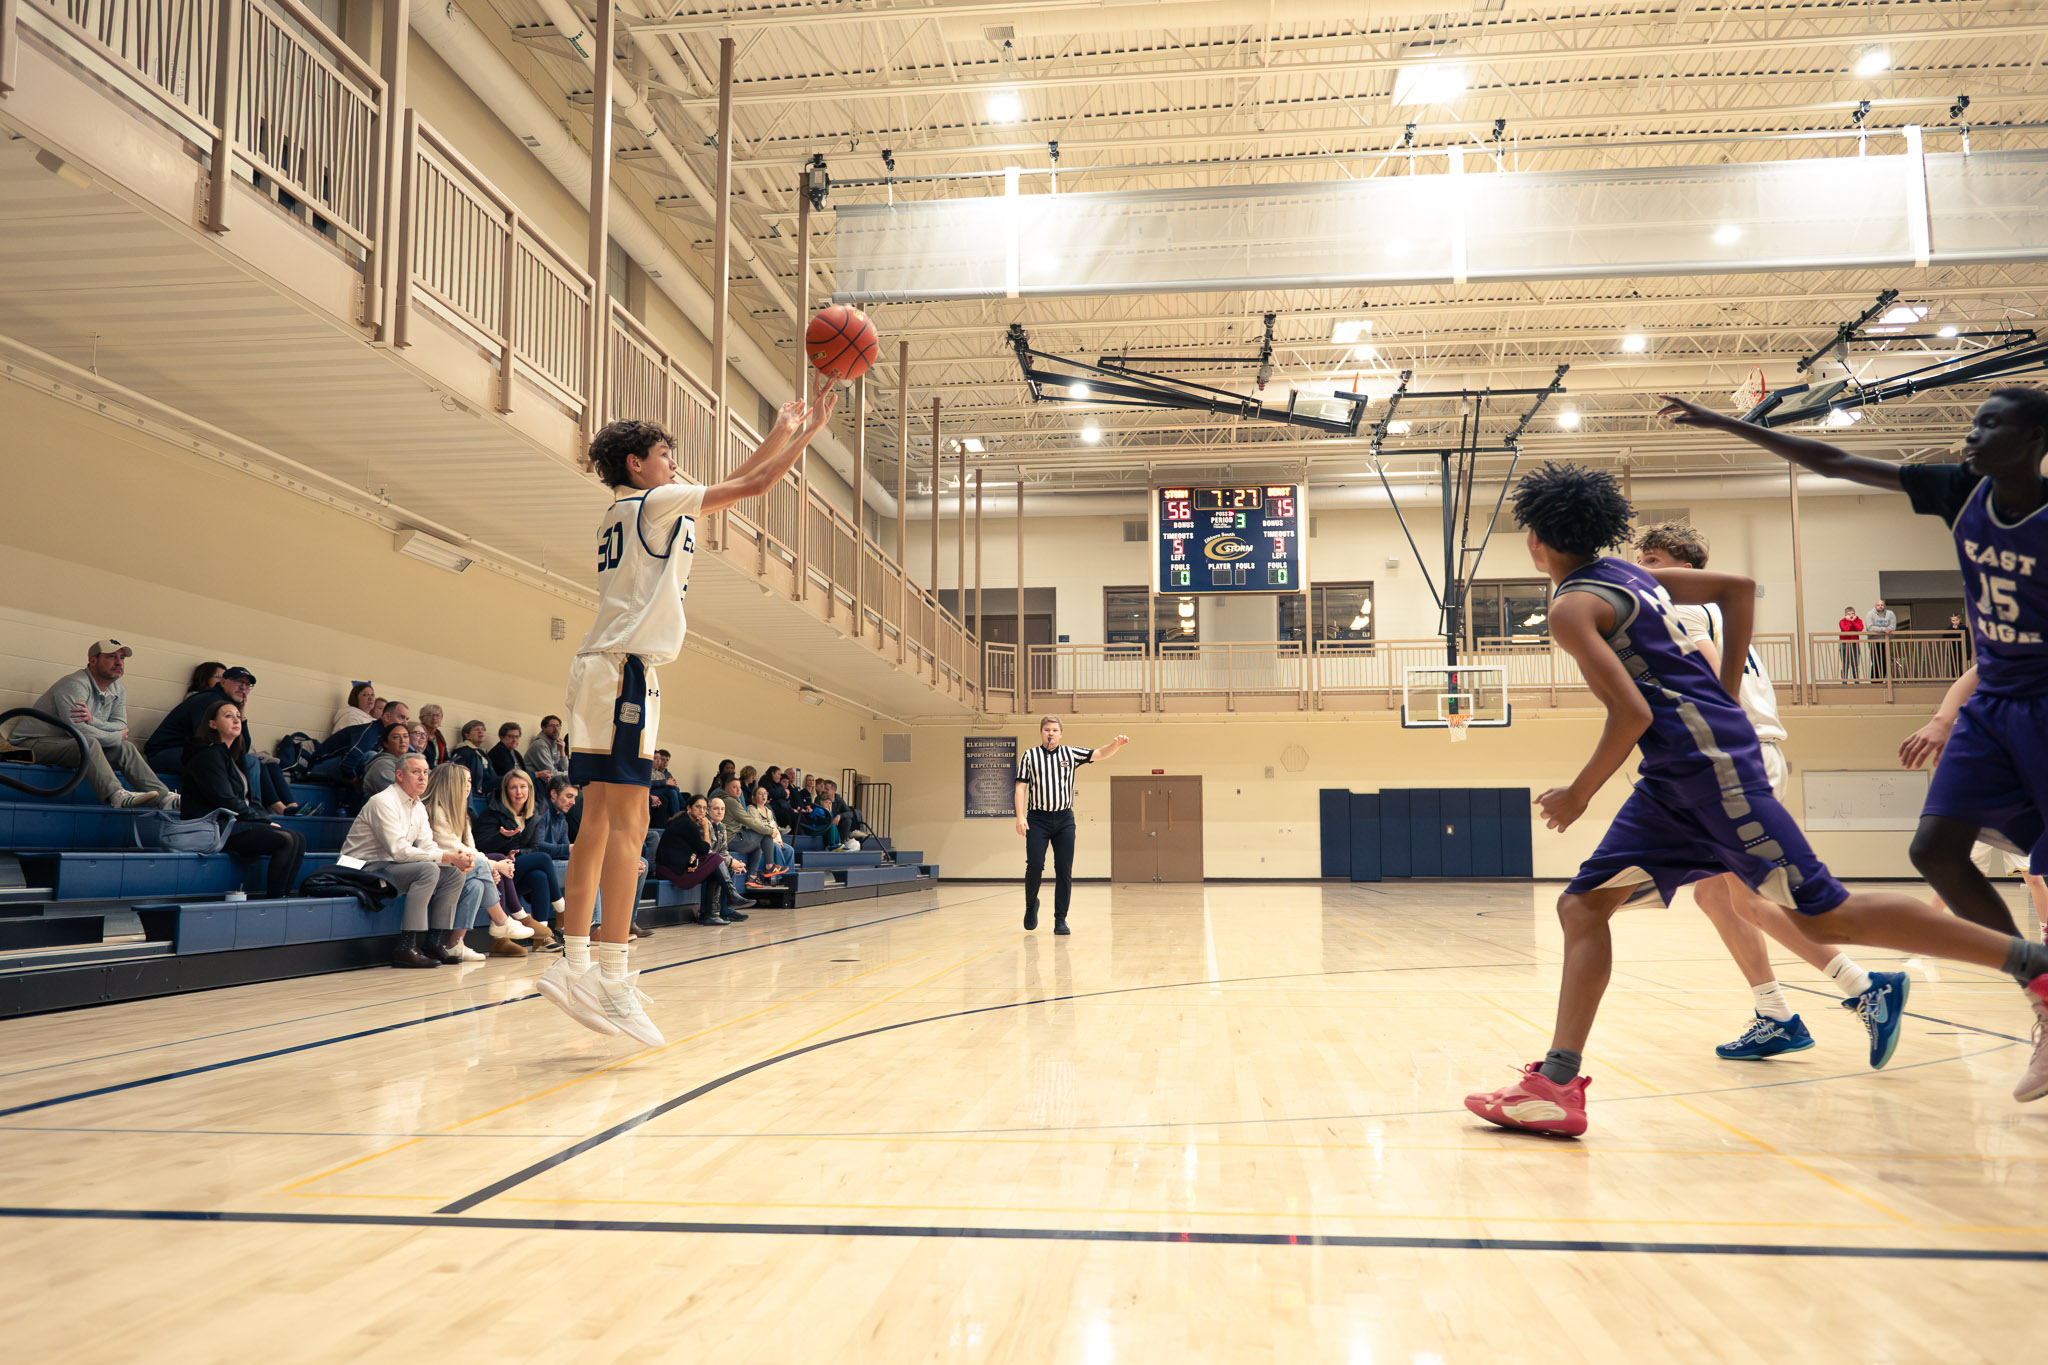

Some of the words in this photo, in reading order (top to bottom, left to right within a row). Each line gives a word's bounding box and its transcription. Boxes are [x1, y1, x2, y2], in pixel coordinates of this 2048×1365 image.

[1164, 490, 1189, 498] STORM
[1211, 490, 1257, 507] 7:27
[1168, 501, 1190, 519] 56
[1278, 500, 1294, 517] 15
[1236, 513, 1246, 528] 3
[1174, 540, 1183, 554] 5
[1275, 538, 1284, 552] 3
[1964, 539, 2037, 576] EAST
[1180, 571, 1190, 585] 0
[1278, 569, 1287, 583] 0
[1976, 572, 2020, 622] 15
